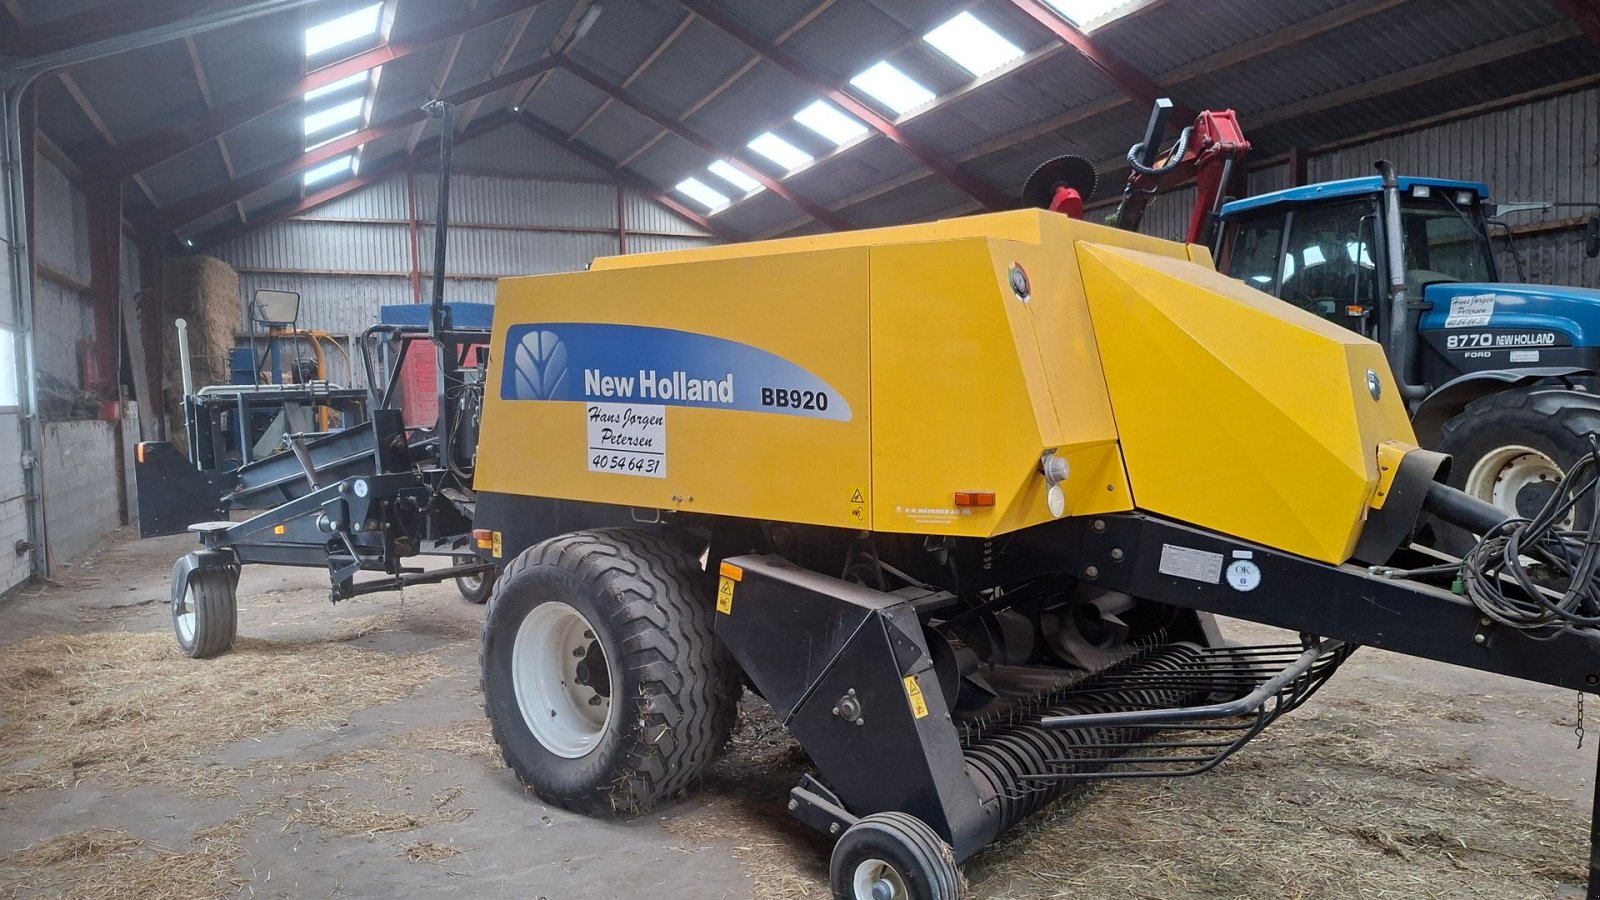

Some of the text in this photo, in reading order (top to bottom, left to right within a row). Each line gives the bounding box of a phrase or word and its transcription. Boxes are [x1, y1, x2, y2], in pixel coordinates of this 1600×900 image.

[1446, 333, 1555, 348] 8770 NEW HOLLAND
[584, 368, 828, 412] New Holland BB920
[588, 406, 621, 423] Hans
[601, 427, 653, 447] Petersen
[1235, 565, 1250, 574] OK
